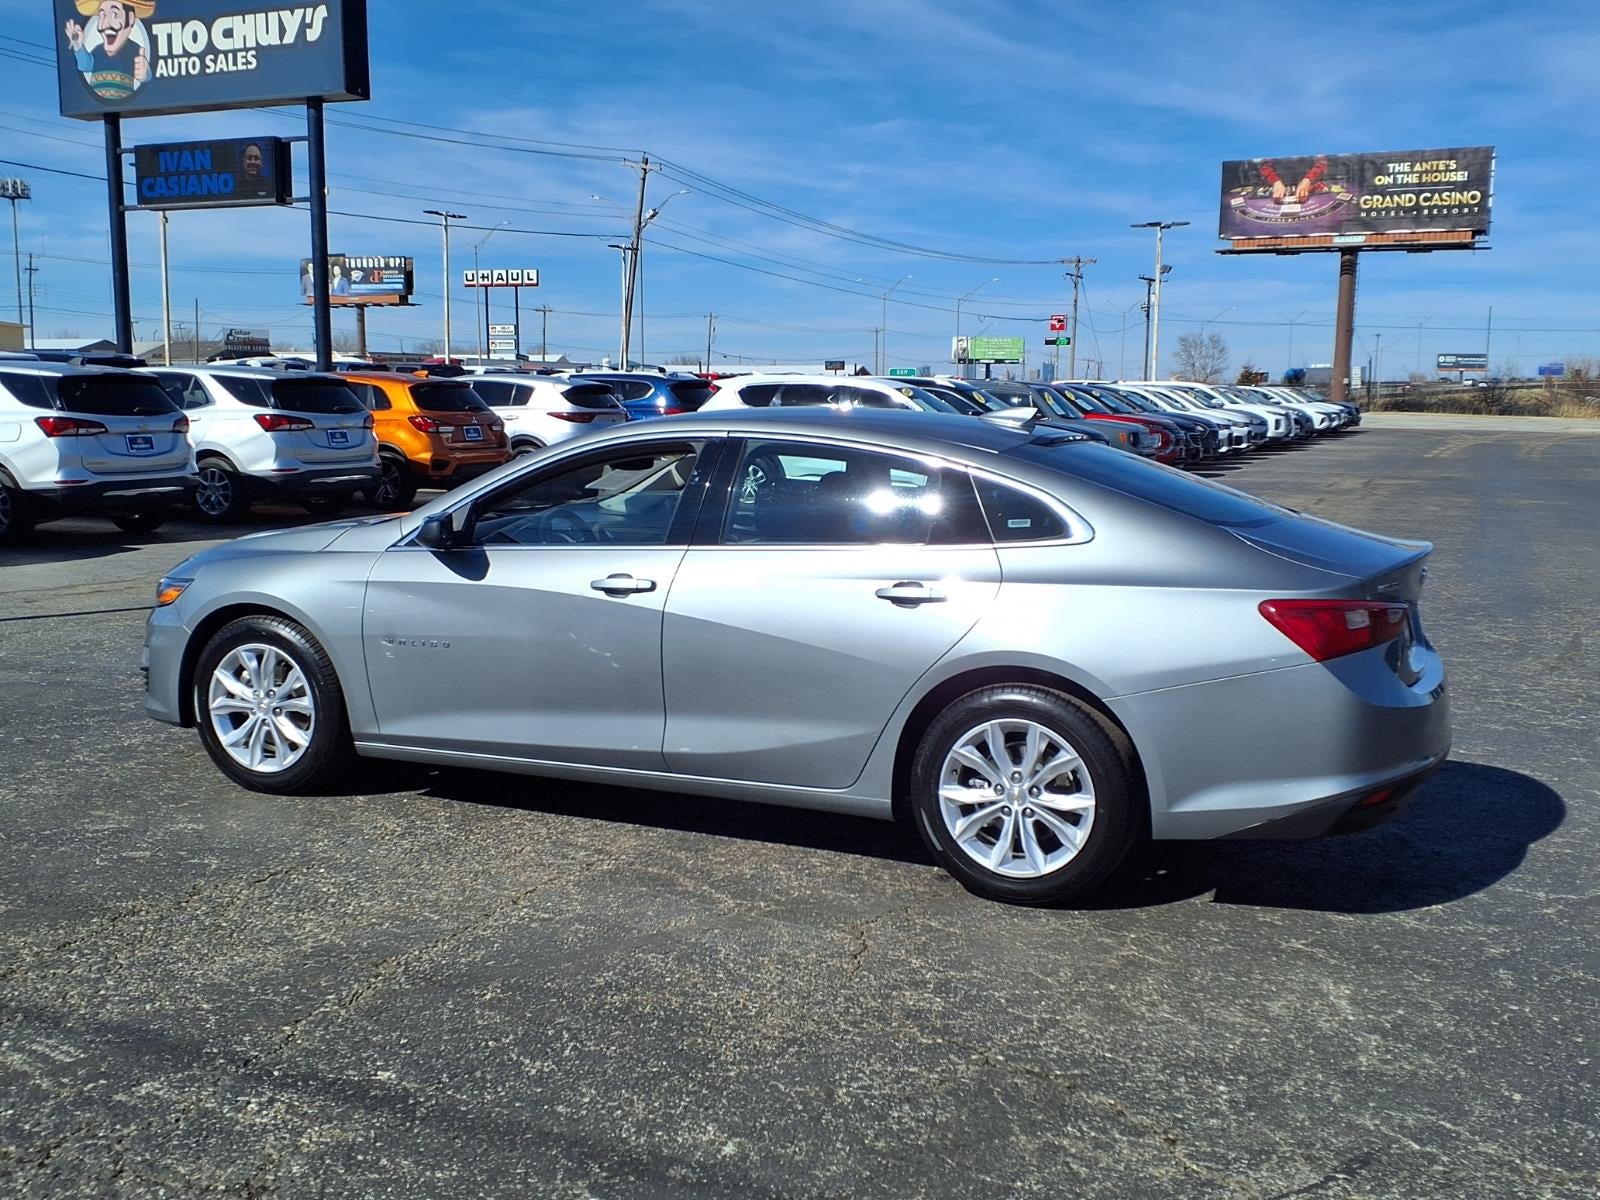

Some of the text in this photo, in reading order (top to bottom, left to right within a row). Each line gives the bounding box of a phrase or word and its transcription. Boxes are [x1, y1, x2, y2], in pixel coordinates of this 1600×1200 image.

[152, 4, 328, 56] TIO CHUY'S
[155, 50, 257, 78] AUTO SALES
[159, 149, 212, 172] IVAN
[1387, 159, 1457, 173] THE ANTE'S
[141, 172, 235, 198] CASIANO
[1374, 171, 1468, 185] ON THE HOUSE!
[1360, 190, 1481, 209] GRAND CASINO
[1423, 207, 1479, 215] RESORT
[345, 256, 385, 268] THUNDER
